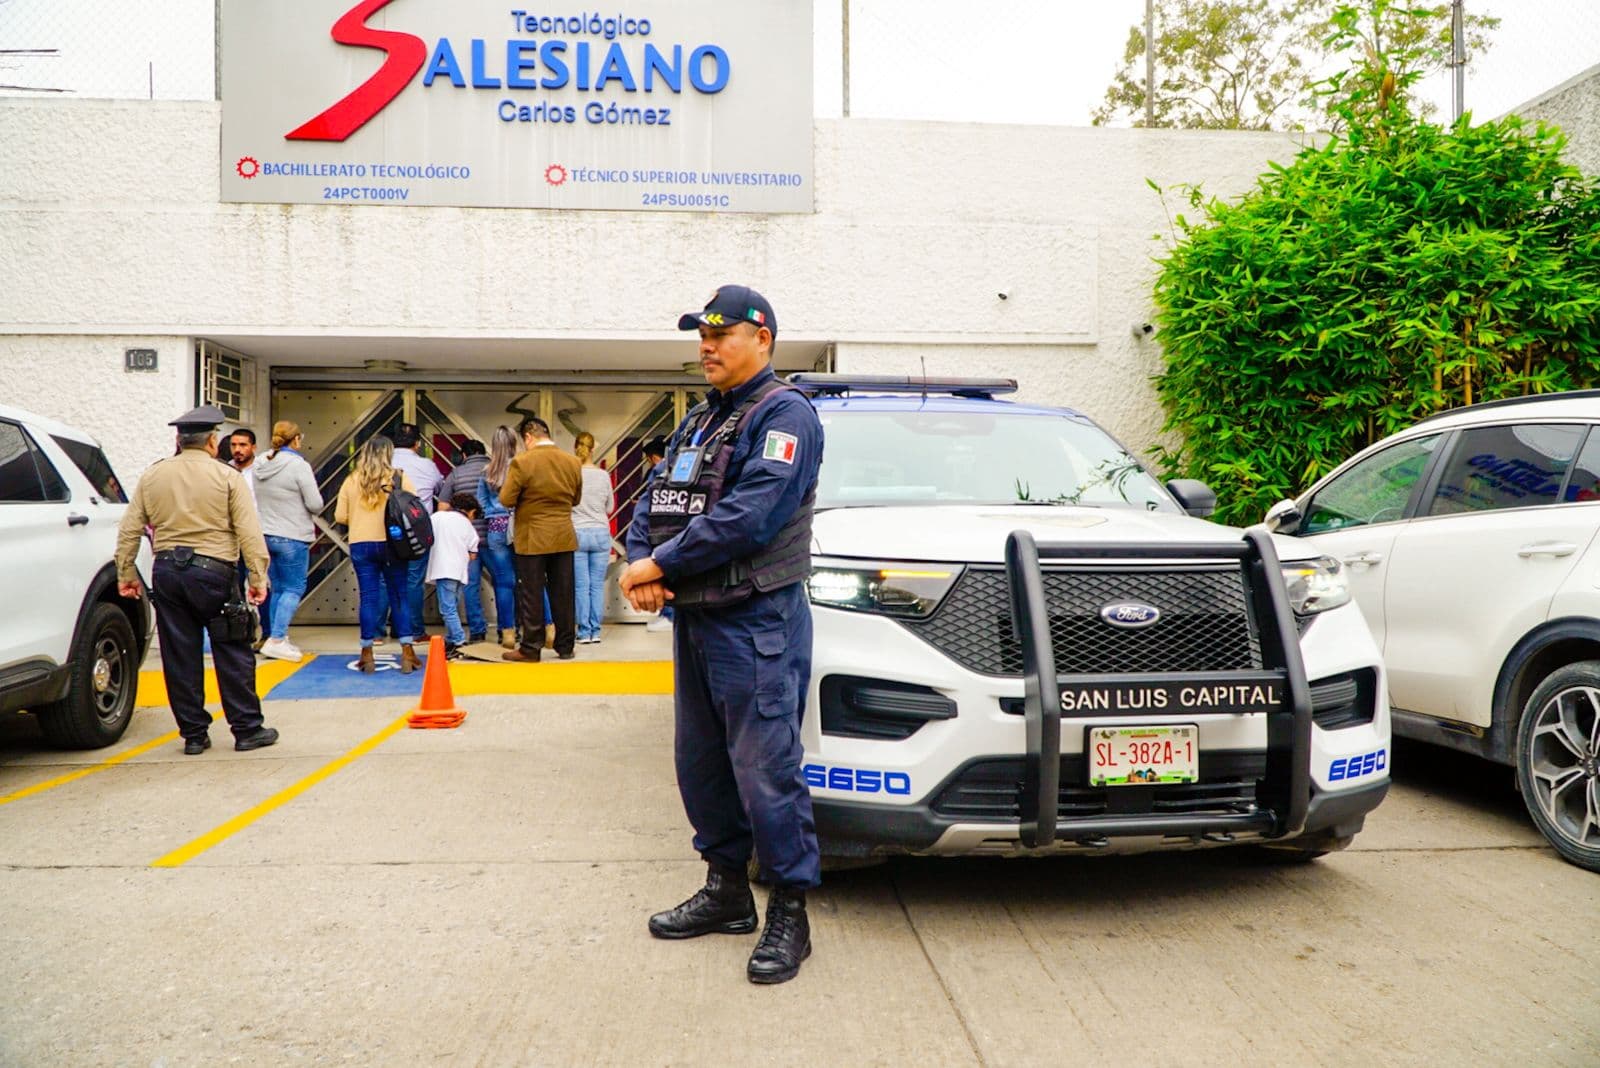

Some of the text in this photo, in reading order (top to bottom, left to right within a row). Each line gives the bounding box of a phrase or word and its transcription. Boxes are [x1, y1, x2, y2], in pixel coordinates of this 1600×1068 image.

[511, 11, 652, 39] Tecnológico
[499, 100, 671, 126] Carlos Gómez
[263, 162, 470, 179] BACHILLERATO TECNOLÓGICO
[571, 167, 802, 187] TÉCNICO SUPERIOR UNIVERSITARIO
[324, 187, 409, 200] 24PCT0001V
[642, 193, 729, 207] 24PSU0051C
[652, 490, 688, 505] SSPC
[1117, 606, 1148, 621] Ford
[1061, 686, 1281, 710] SAN LUIS CAPITAL
[1096, 741, 1192, 767] SL-382A-1
[1328, 748, 1386, 782] 6650
[802, 763, 911, 795] 6650
